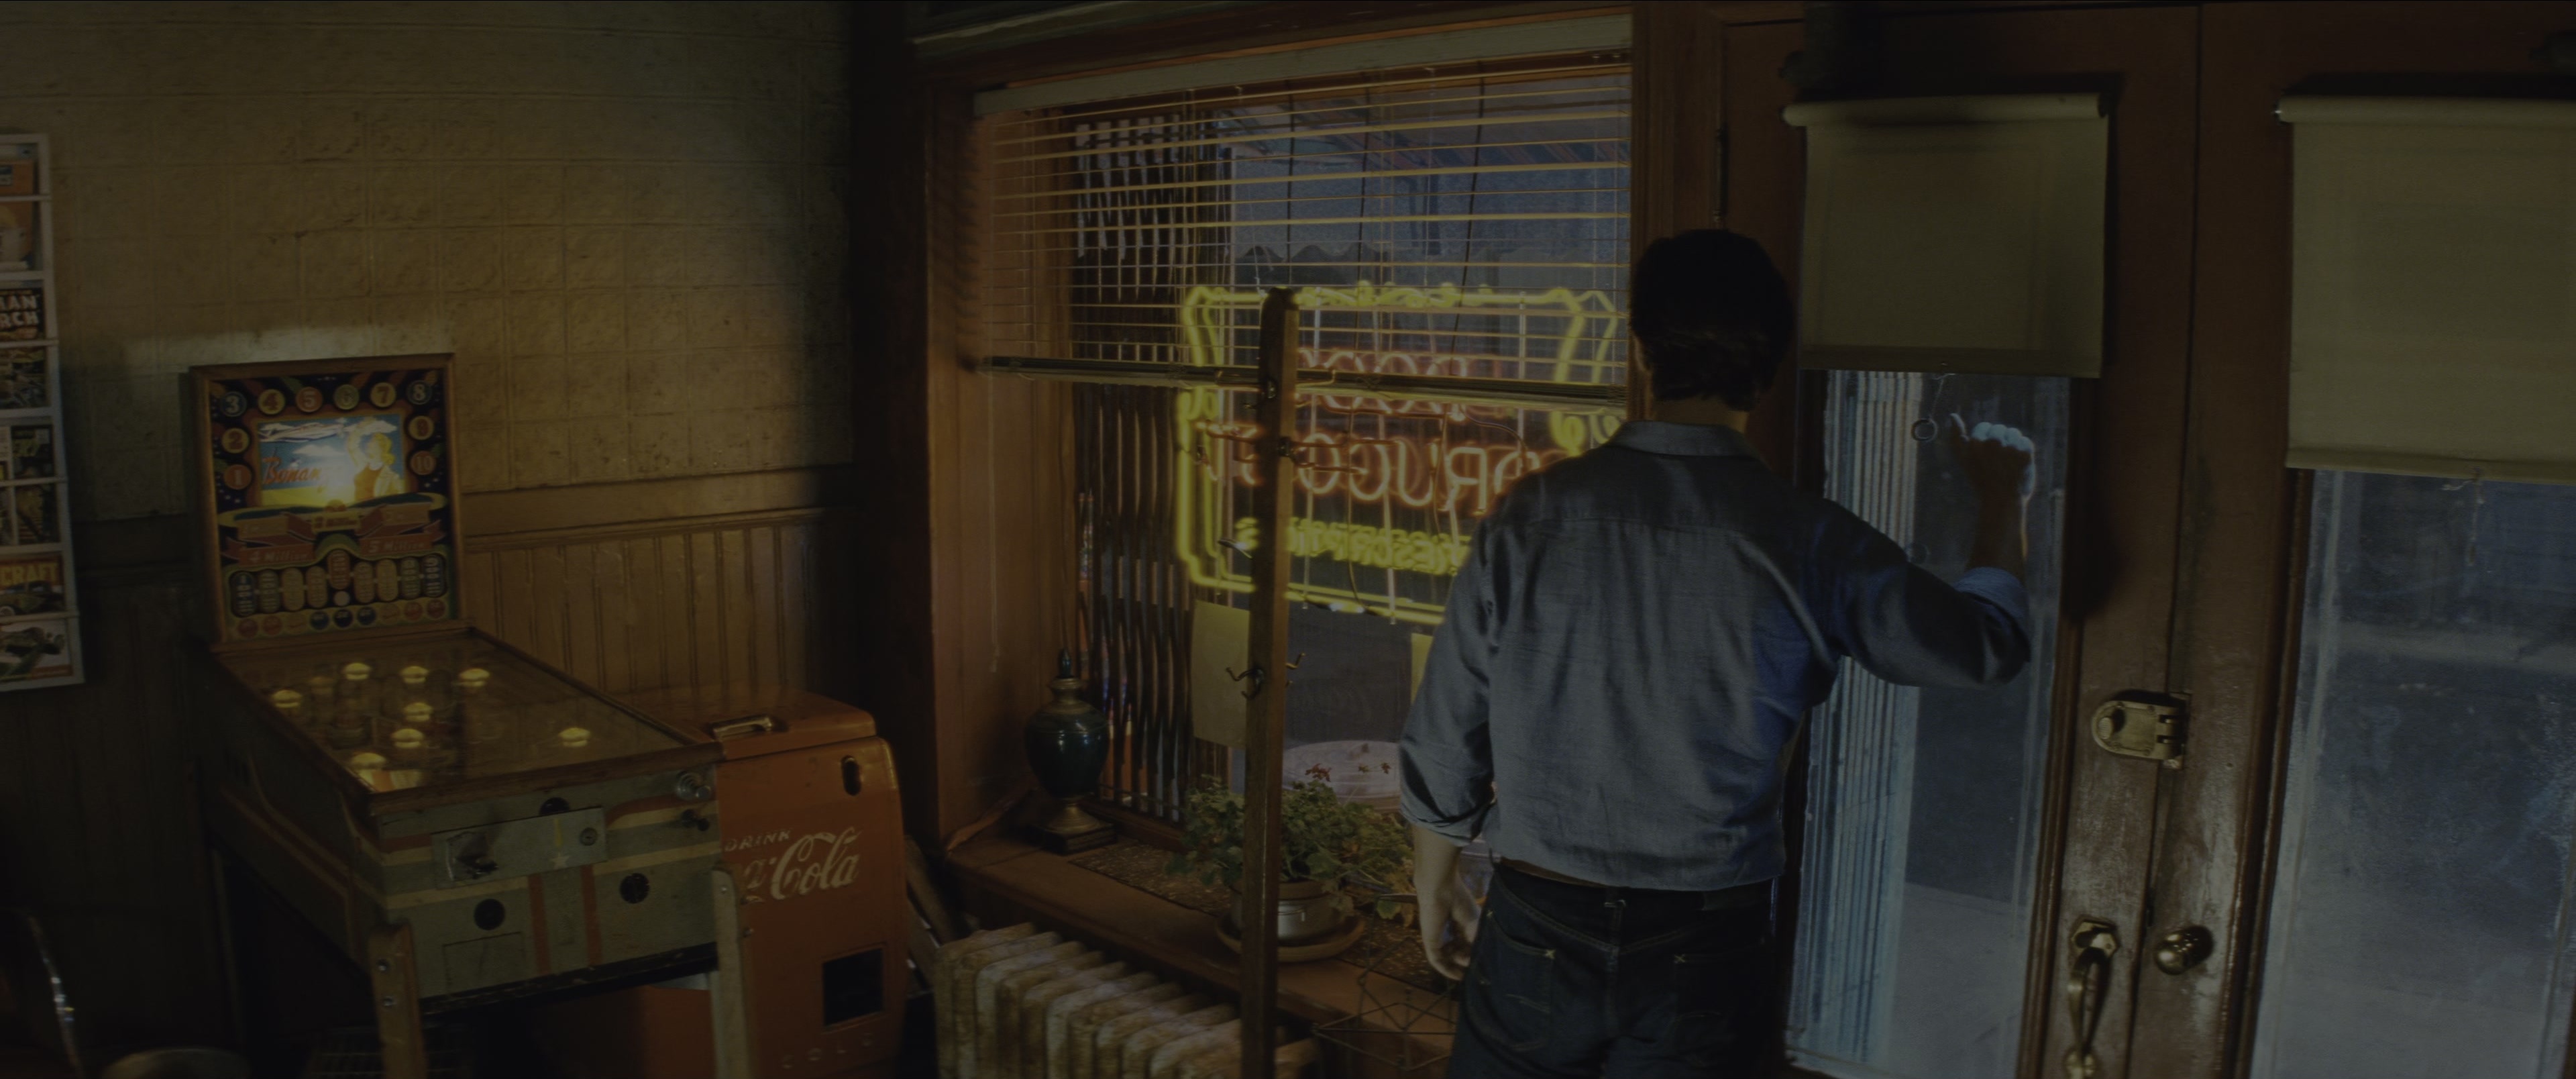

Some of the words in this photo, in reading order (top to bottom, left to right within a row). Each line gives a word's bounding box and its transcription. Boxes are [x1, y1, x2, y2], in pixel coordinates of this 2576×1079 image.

[303, 391, 315, 407] 5
[376, 386, 390, 403] 7
[413, 384, 426, 401] 8
[225, 395, 240, 413] 3
[262, 393, 278, 411] 4
[417, 419, 430, 437] 9
[229, 431, 243, 450] 2
[417, 456, 432, 470] 10
[235, 469, 242, 486] 1
[724, 827, 793, 852] DRINK
